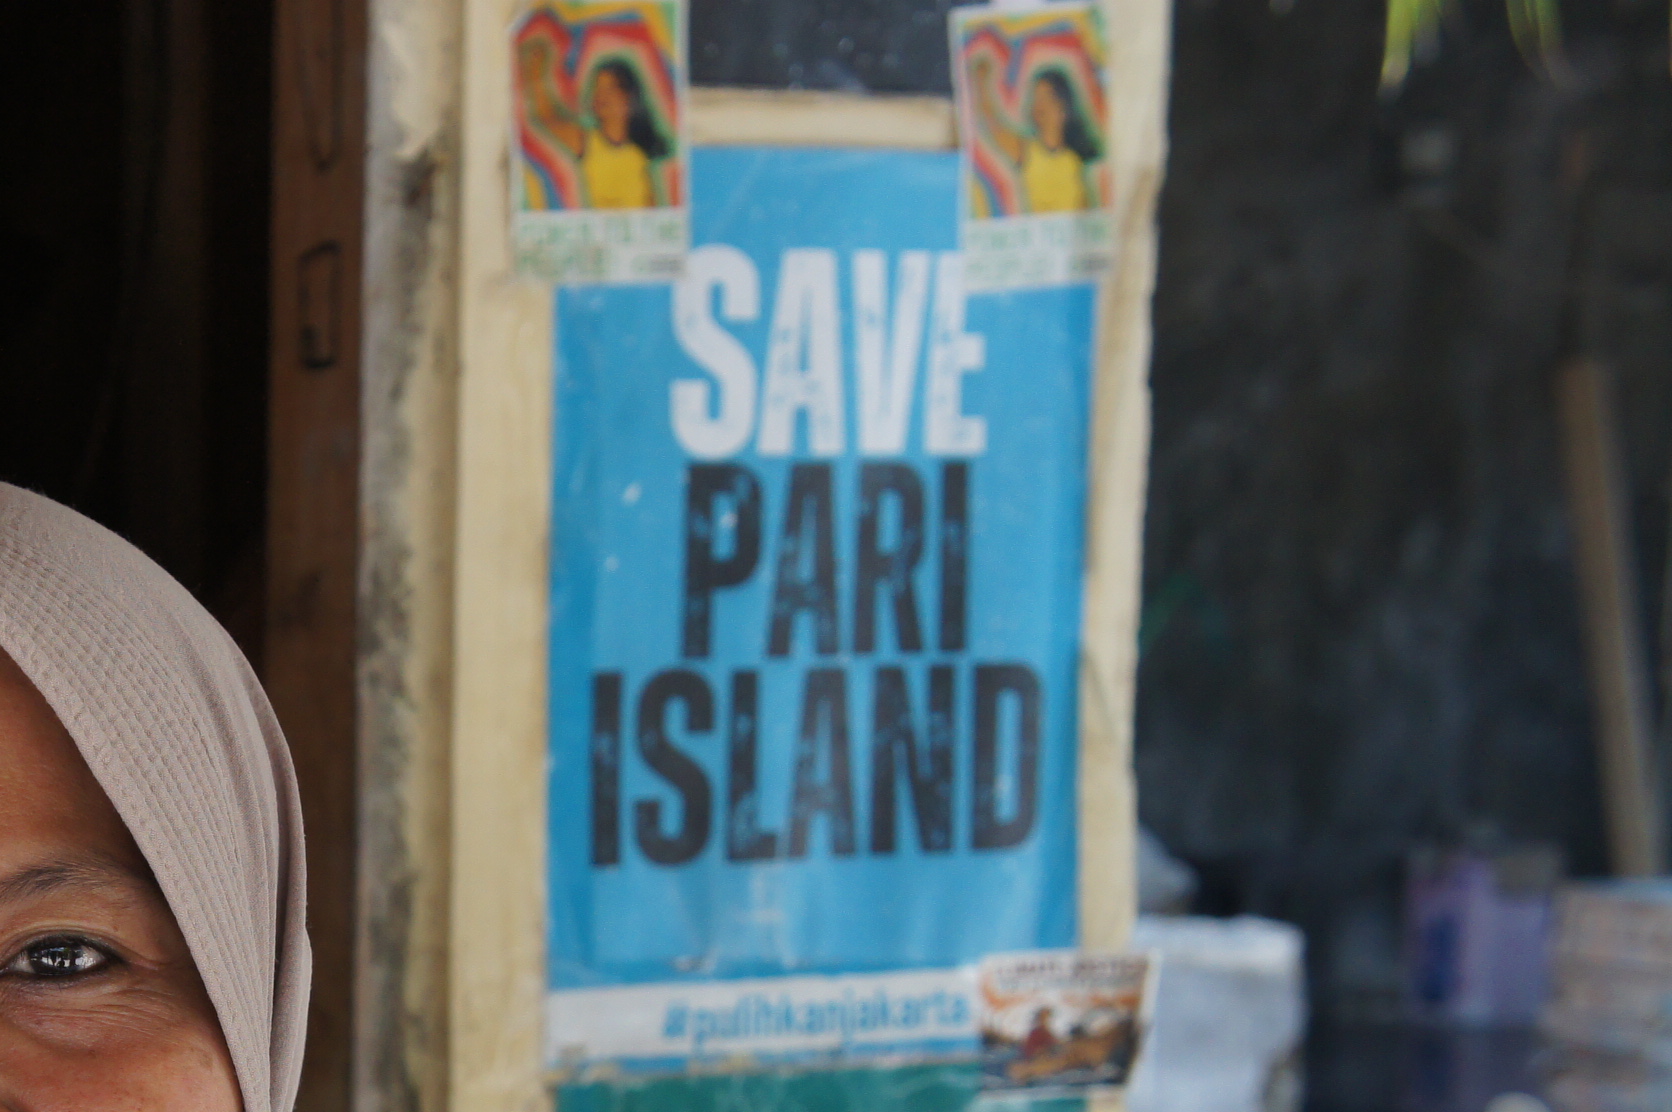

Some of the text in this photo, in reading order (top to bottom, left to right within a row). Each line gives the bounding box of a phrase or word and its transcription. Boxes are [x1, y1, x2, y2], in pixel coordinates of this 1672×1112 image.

[669, 243, 988, 458] SAVE
[681, 461, 971, 659] PARI
[589, 661, 1044, 868] ISLAND
